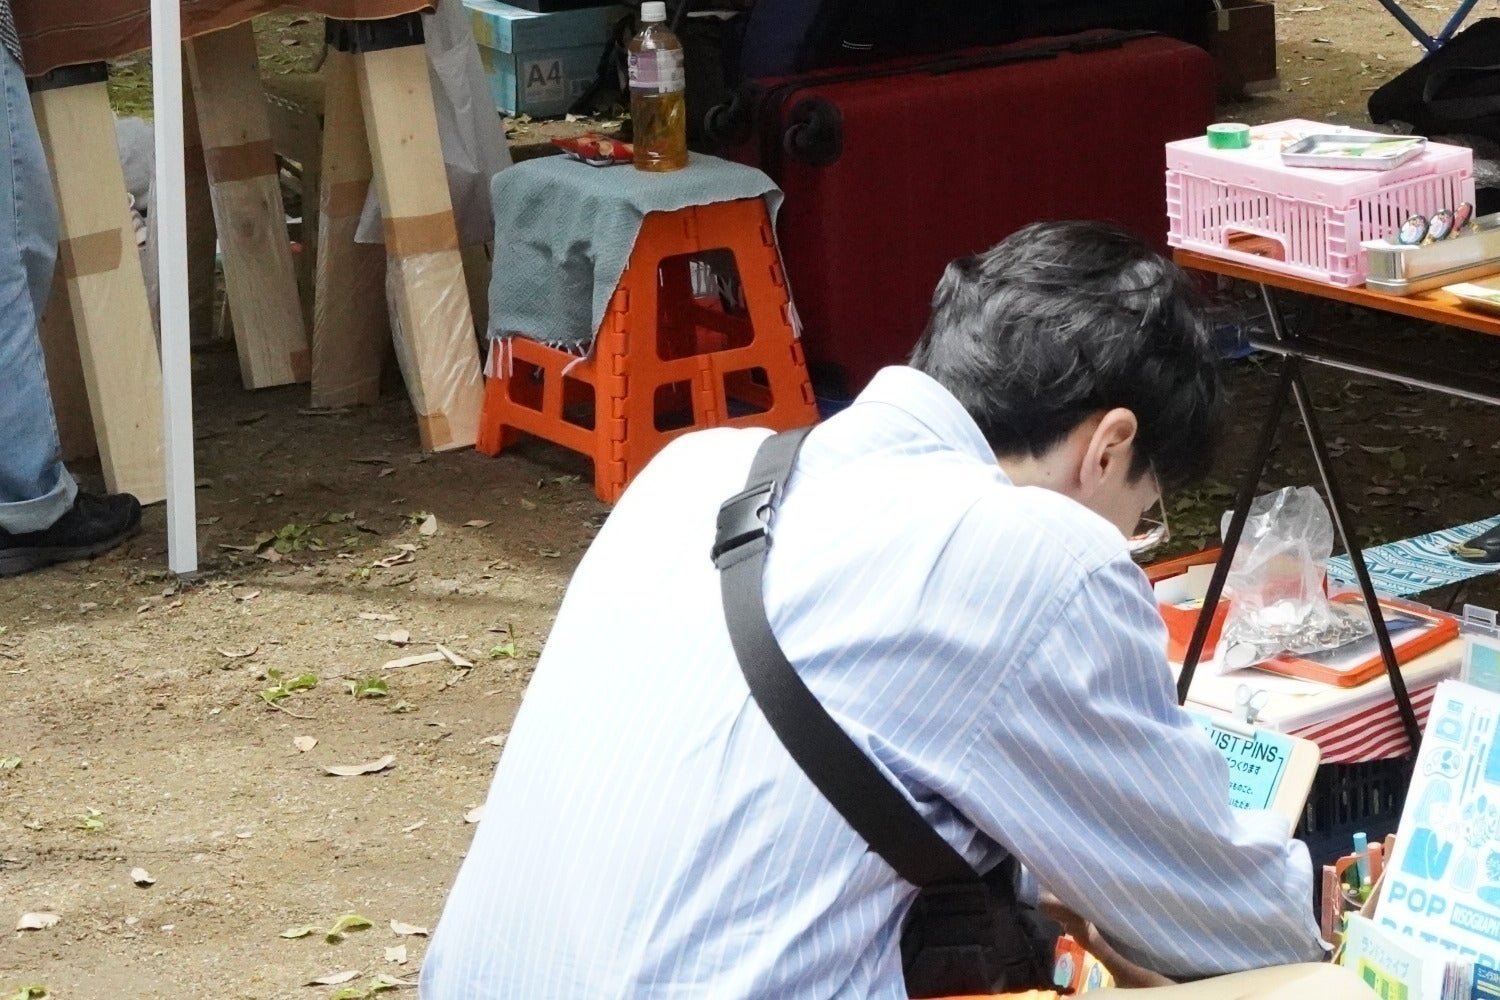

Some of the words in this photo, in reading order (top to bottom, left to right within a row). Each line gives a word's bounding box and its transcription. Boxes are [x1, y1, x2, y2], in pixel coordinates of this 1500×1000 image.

[526, 60, 562, 89] A4
[1240, 740, 1279, 763] PINS
[1387, 880, 1447, 917] POP
